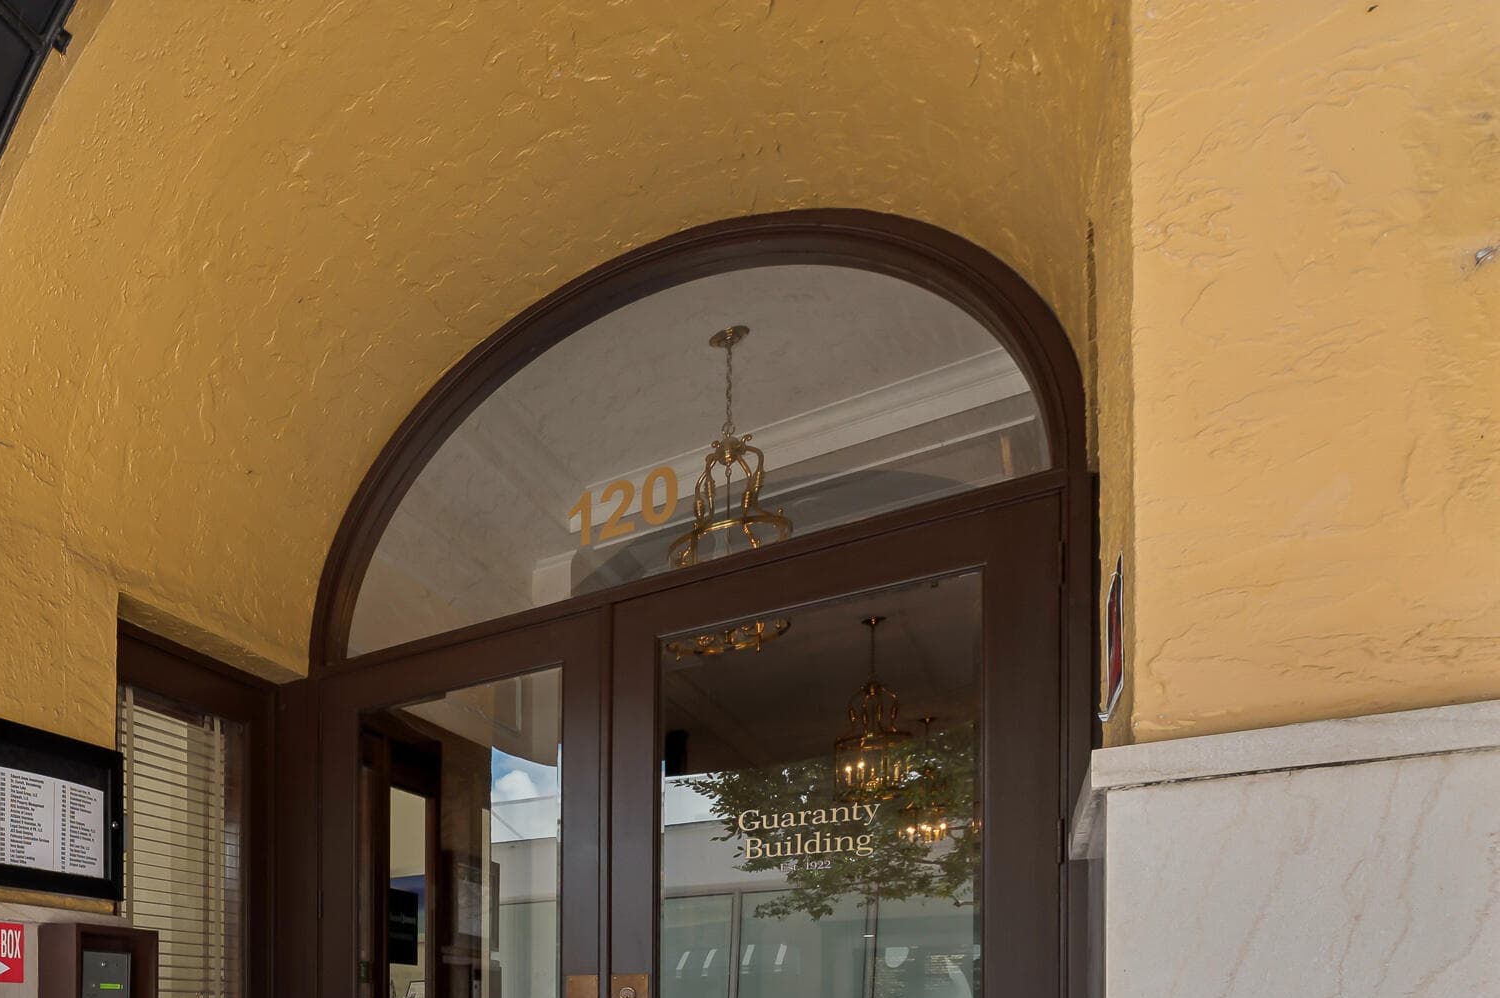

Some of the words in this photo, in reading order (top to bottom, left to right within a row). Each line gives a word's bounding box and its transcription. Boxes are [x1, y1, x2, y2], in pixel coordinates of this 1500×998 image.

[566, 466, 678, 546] 120
[738, 801, 881, 831] Guaranty
[745, 832, 874, 859] Building
[805, 860, 831, 871] 1922
[0, 929, 21, 959] BOX
